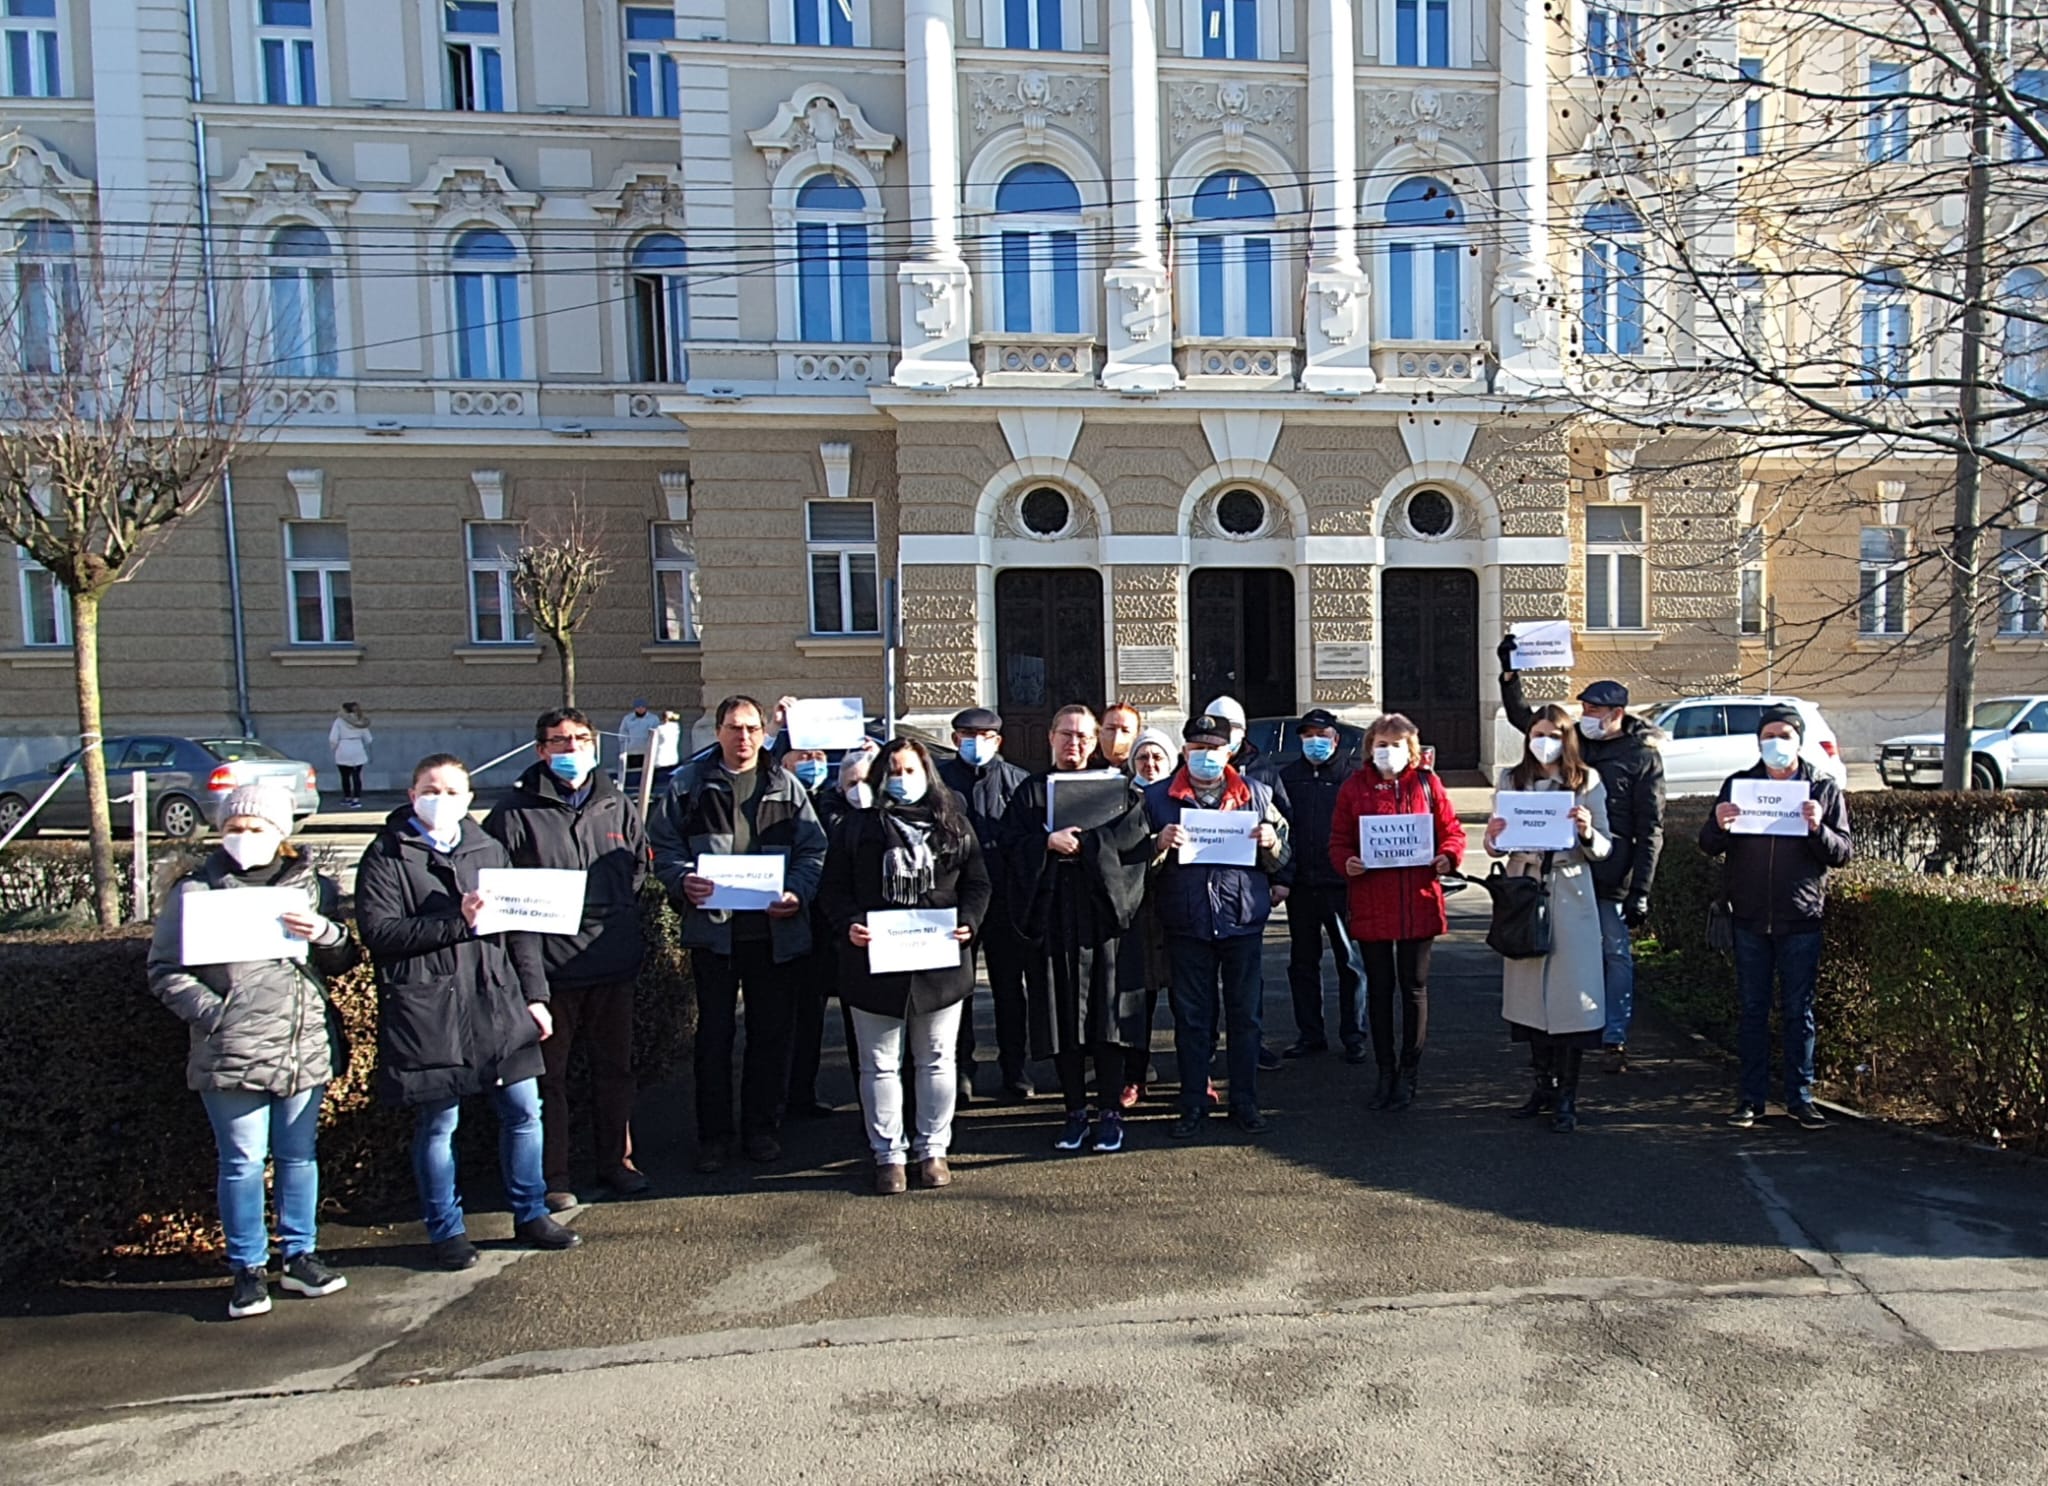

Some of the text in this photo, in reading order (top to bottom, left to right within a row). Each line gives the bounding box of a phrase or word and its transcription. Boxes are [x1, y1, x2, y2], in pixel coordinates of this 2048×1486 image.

[1757, 796, 1782, 805] STOP
[1544, 809, 1557, 817] NU
[1369, 836, 1421, 846] CENTRUL
[1374, 848, 1417, 859] ISTORIC
